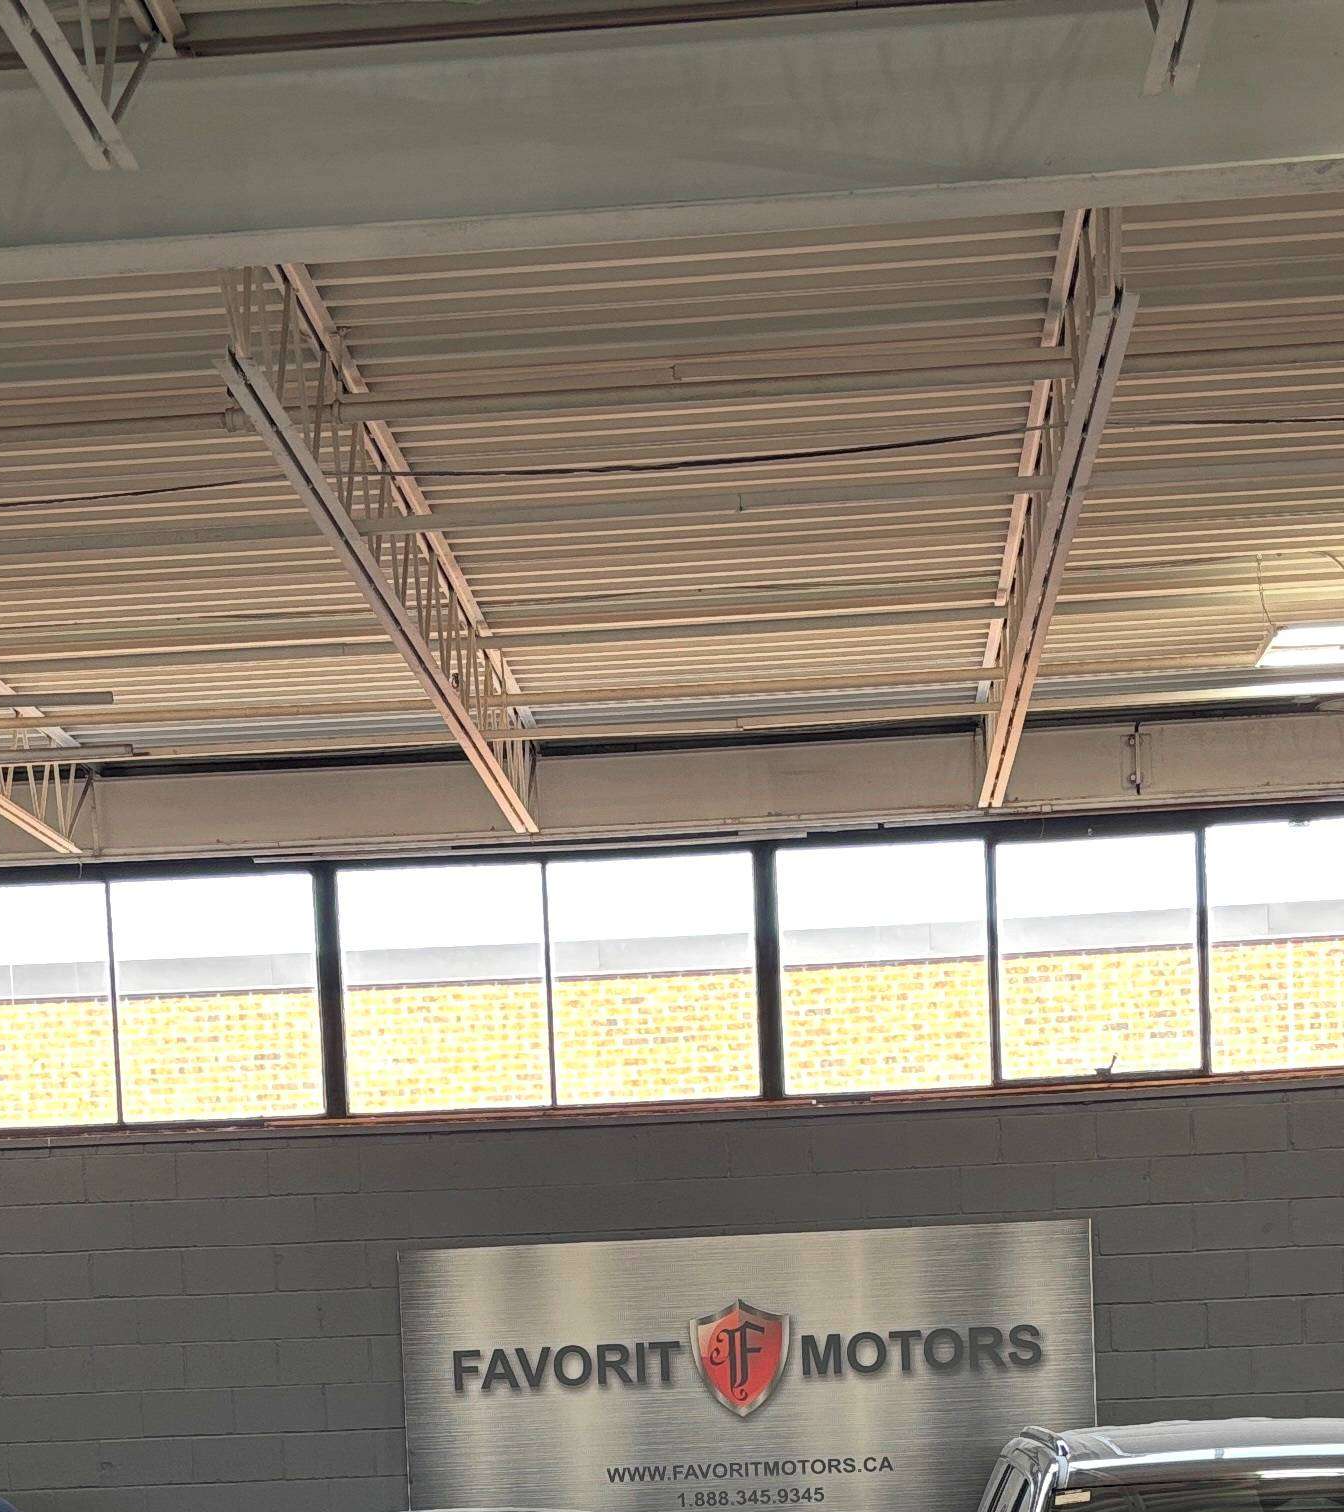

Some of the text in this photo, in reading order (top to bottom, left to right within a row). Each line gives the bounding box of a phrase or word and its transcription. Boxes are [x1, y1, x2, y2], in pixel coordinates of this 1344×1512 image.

[452, 1340, 681, 1392] FAVORIT
[801, 1324, 1042, 1376] MOTORS
[607, 1456, 894, 1483] WWW.FAVORITMOTORS.CA
[677, 1487, 825, 1508] 1.888.345.9345
